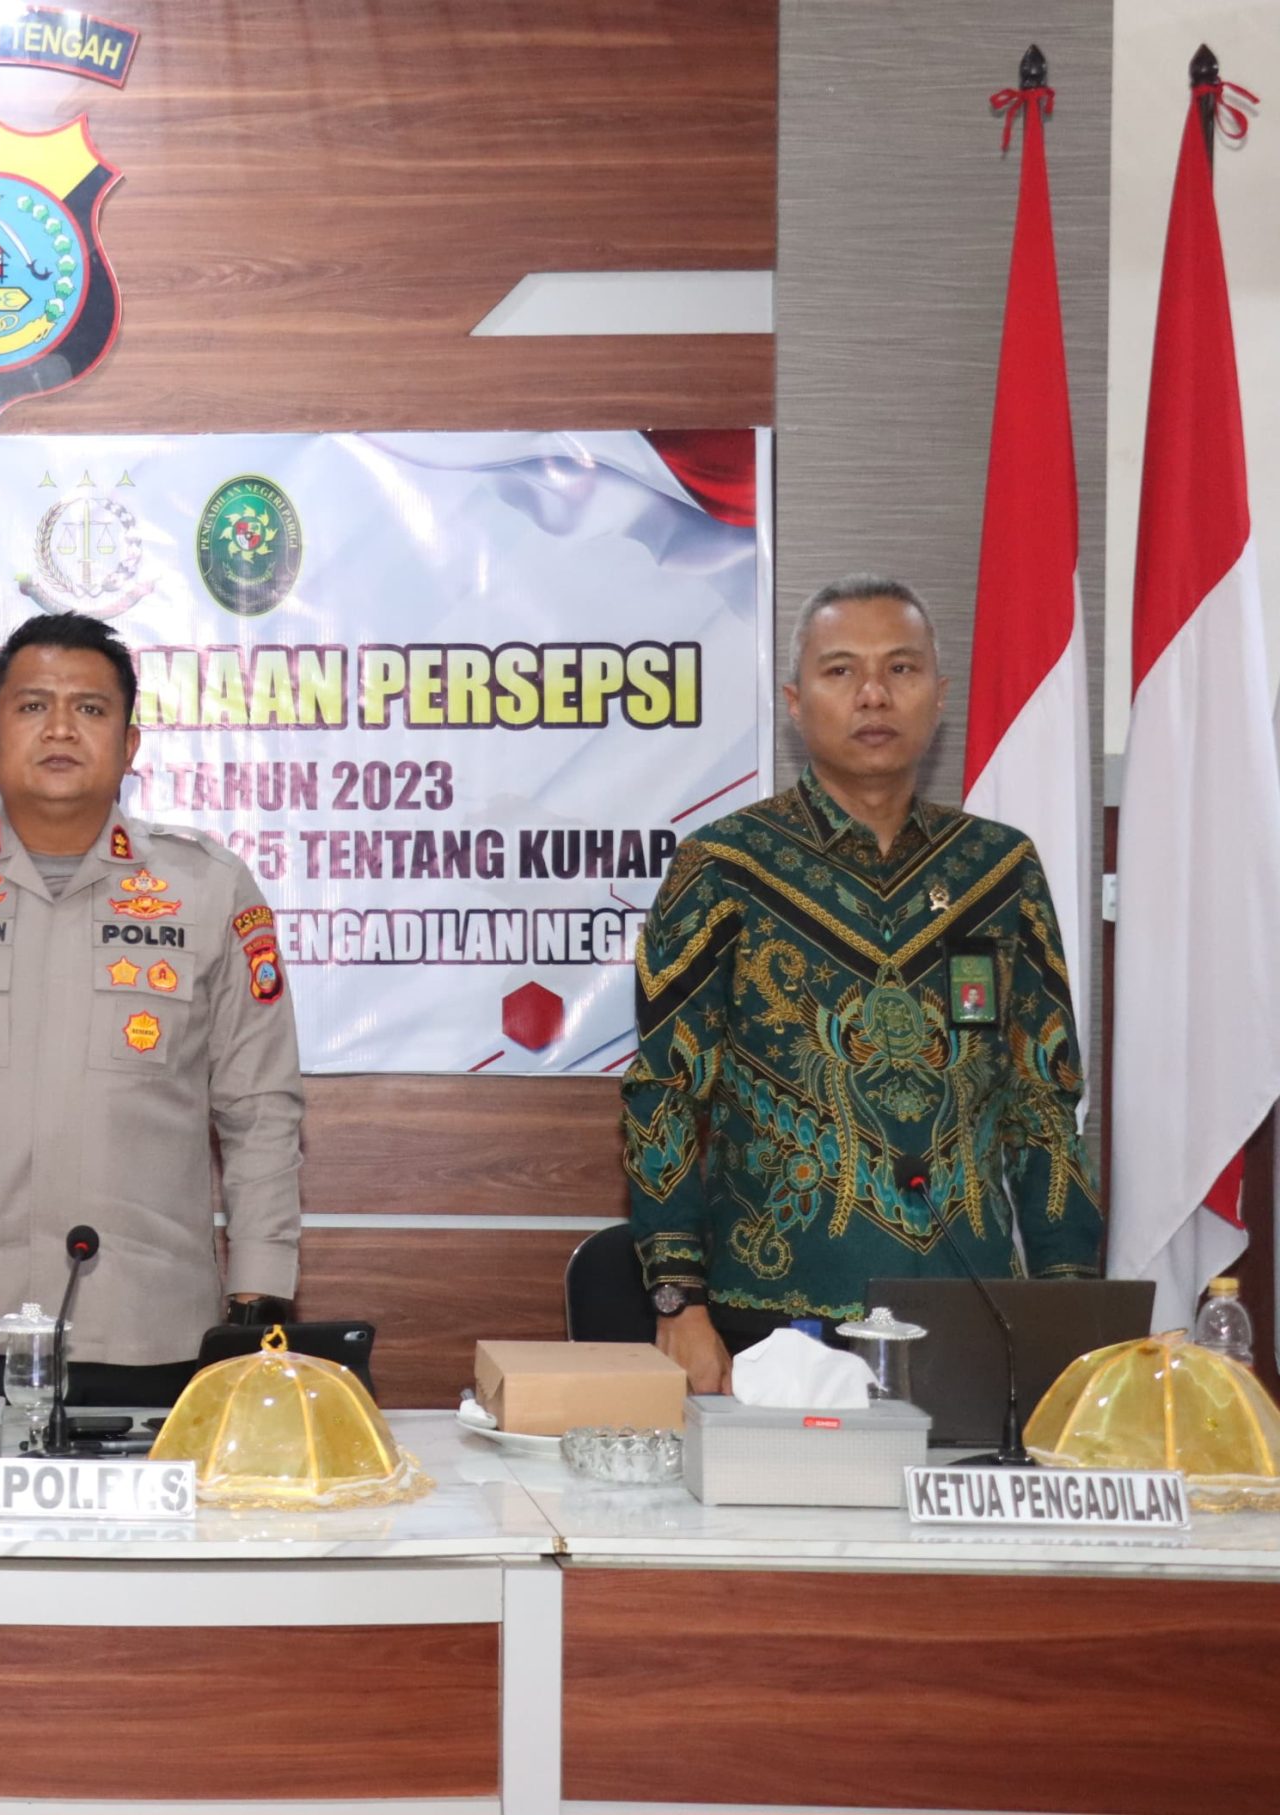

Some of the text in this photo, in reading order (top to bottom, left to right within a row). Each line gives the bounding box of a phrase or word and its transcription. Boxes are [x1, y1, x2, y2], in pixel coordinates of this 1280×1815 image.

[9, 23, 123, 70] TENGAH
[357, 640, 703, 731] PERSEPSI
[166, 760, 318, 812] TAHUN
[332, 759, 454, 811] 2023
[299, 829, 506, 880] TENTANG
[519, 829, 677, 880] KUHAP
[102, 924, 185, 948] POLRI
[274, 908, 528, 966] ENGADILAN
[532, 907, 651, 966] NEGE
[916, 1473, 1183, 1523] KETUA PENGADILAN
